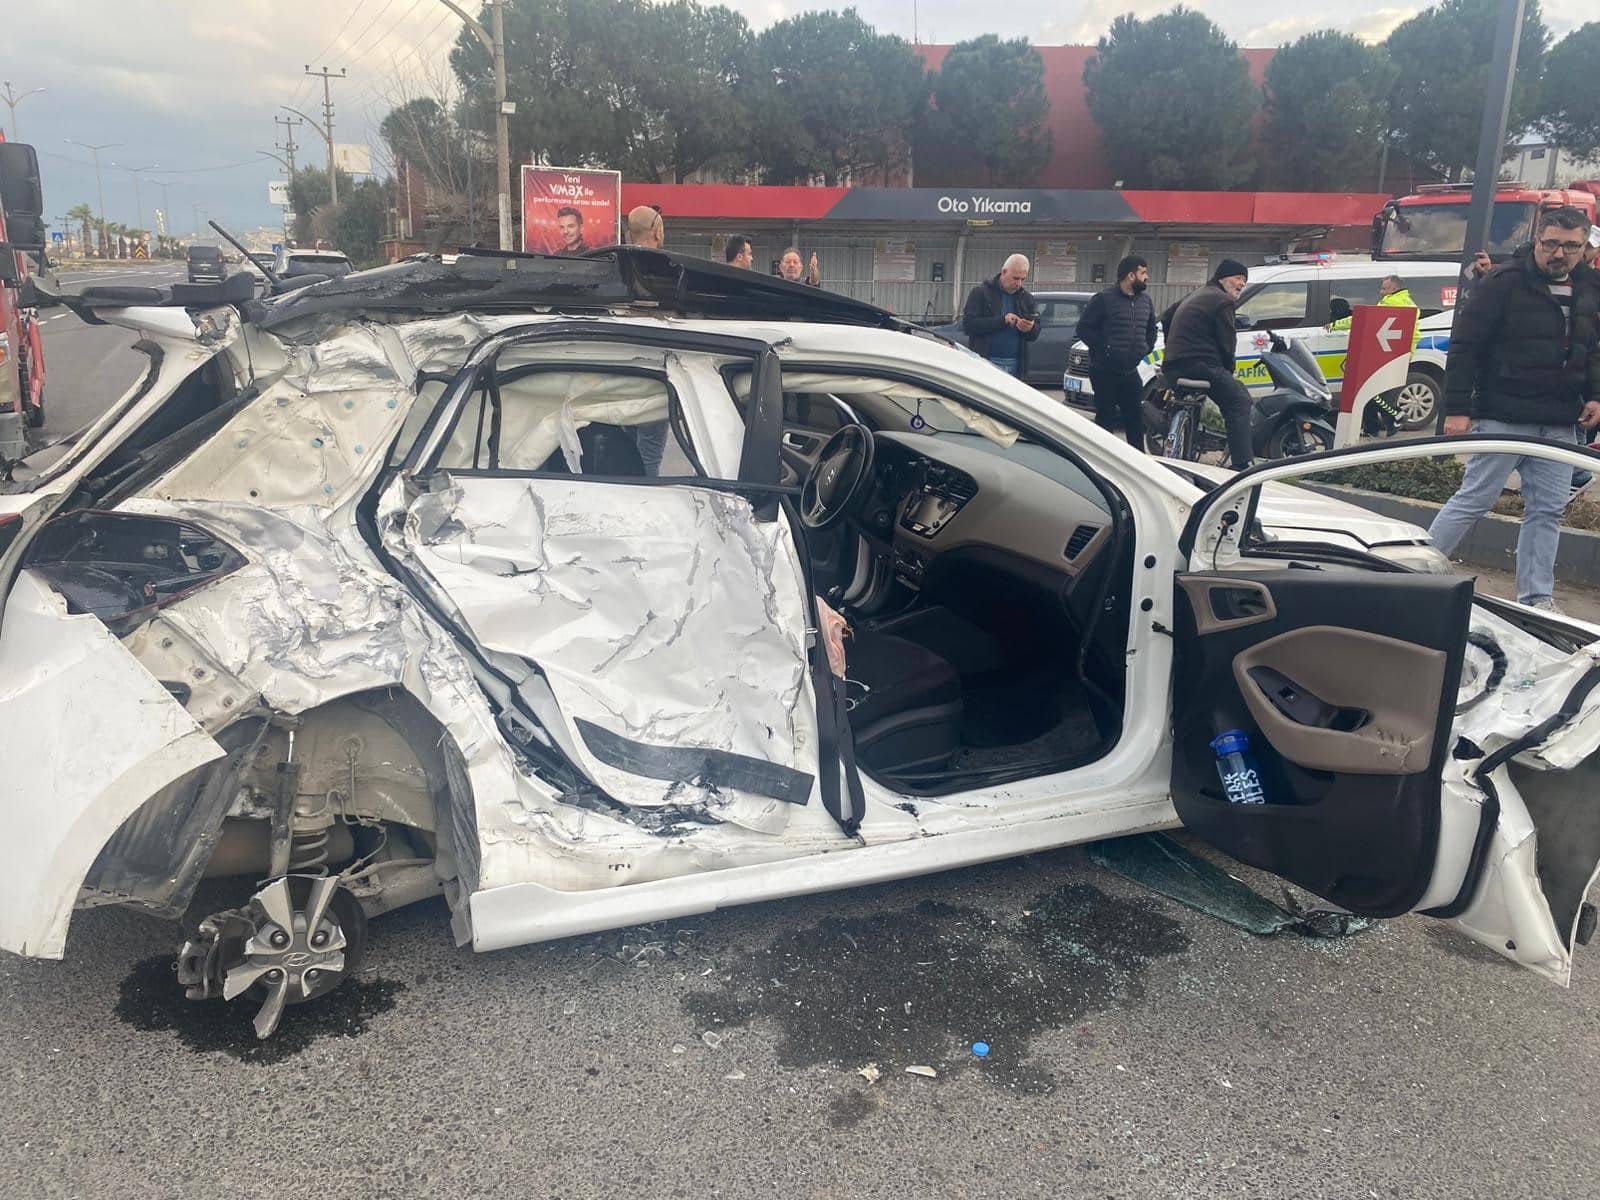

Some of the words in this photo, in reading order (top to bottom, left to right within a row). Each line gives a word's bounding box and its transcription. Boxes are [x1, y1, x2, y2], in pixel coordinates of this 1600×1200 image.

[563, 174, 581, 184] Yeni
[584, 187, 594, 196] ile
[937, 196, 969, 213] Oto
[971, 196, 1032, 213] Yıkama
[1444, 289, 1457, 299] 112
[1224, 772, 1246, 803] EAK
